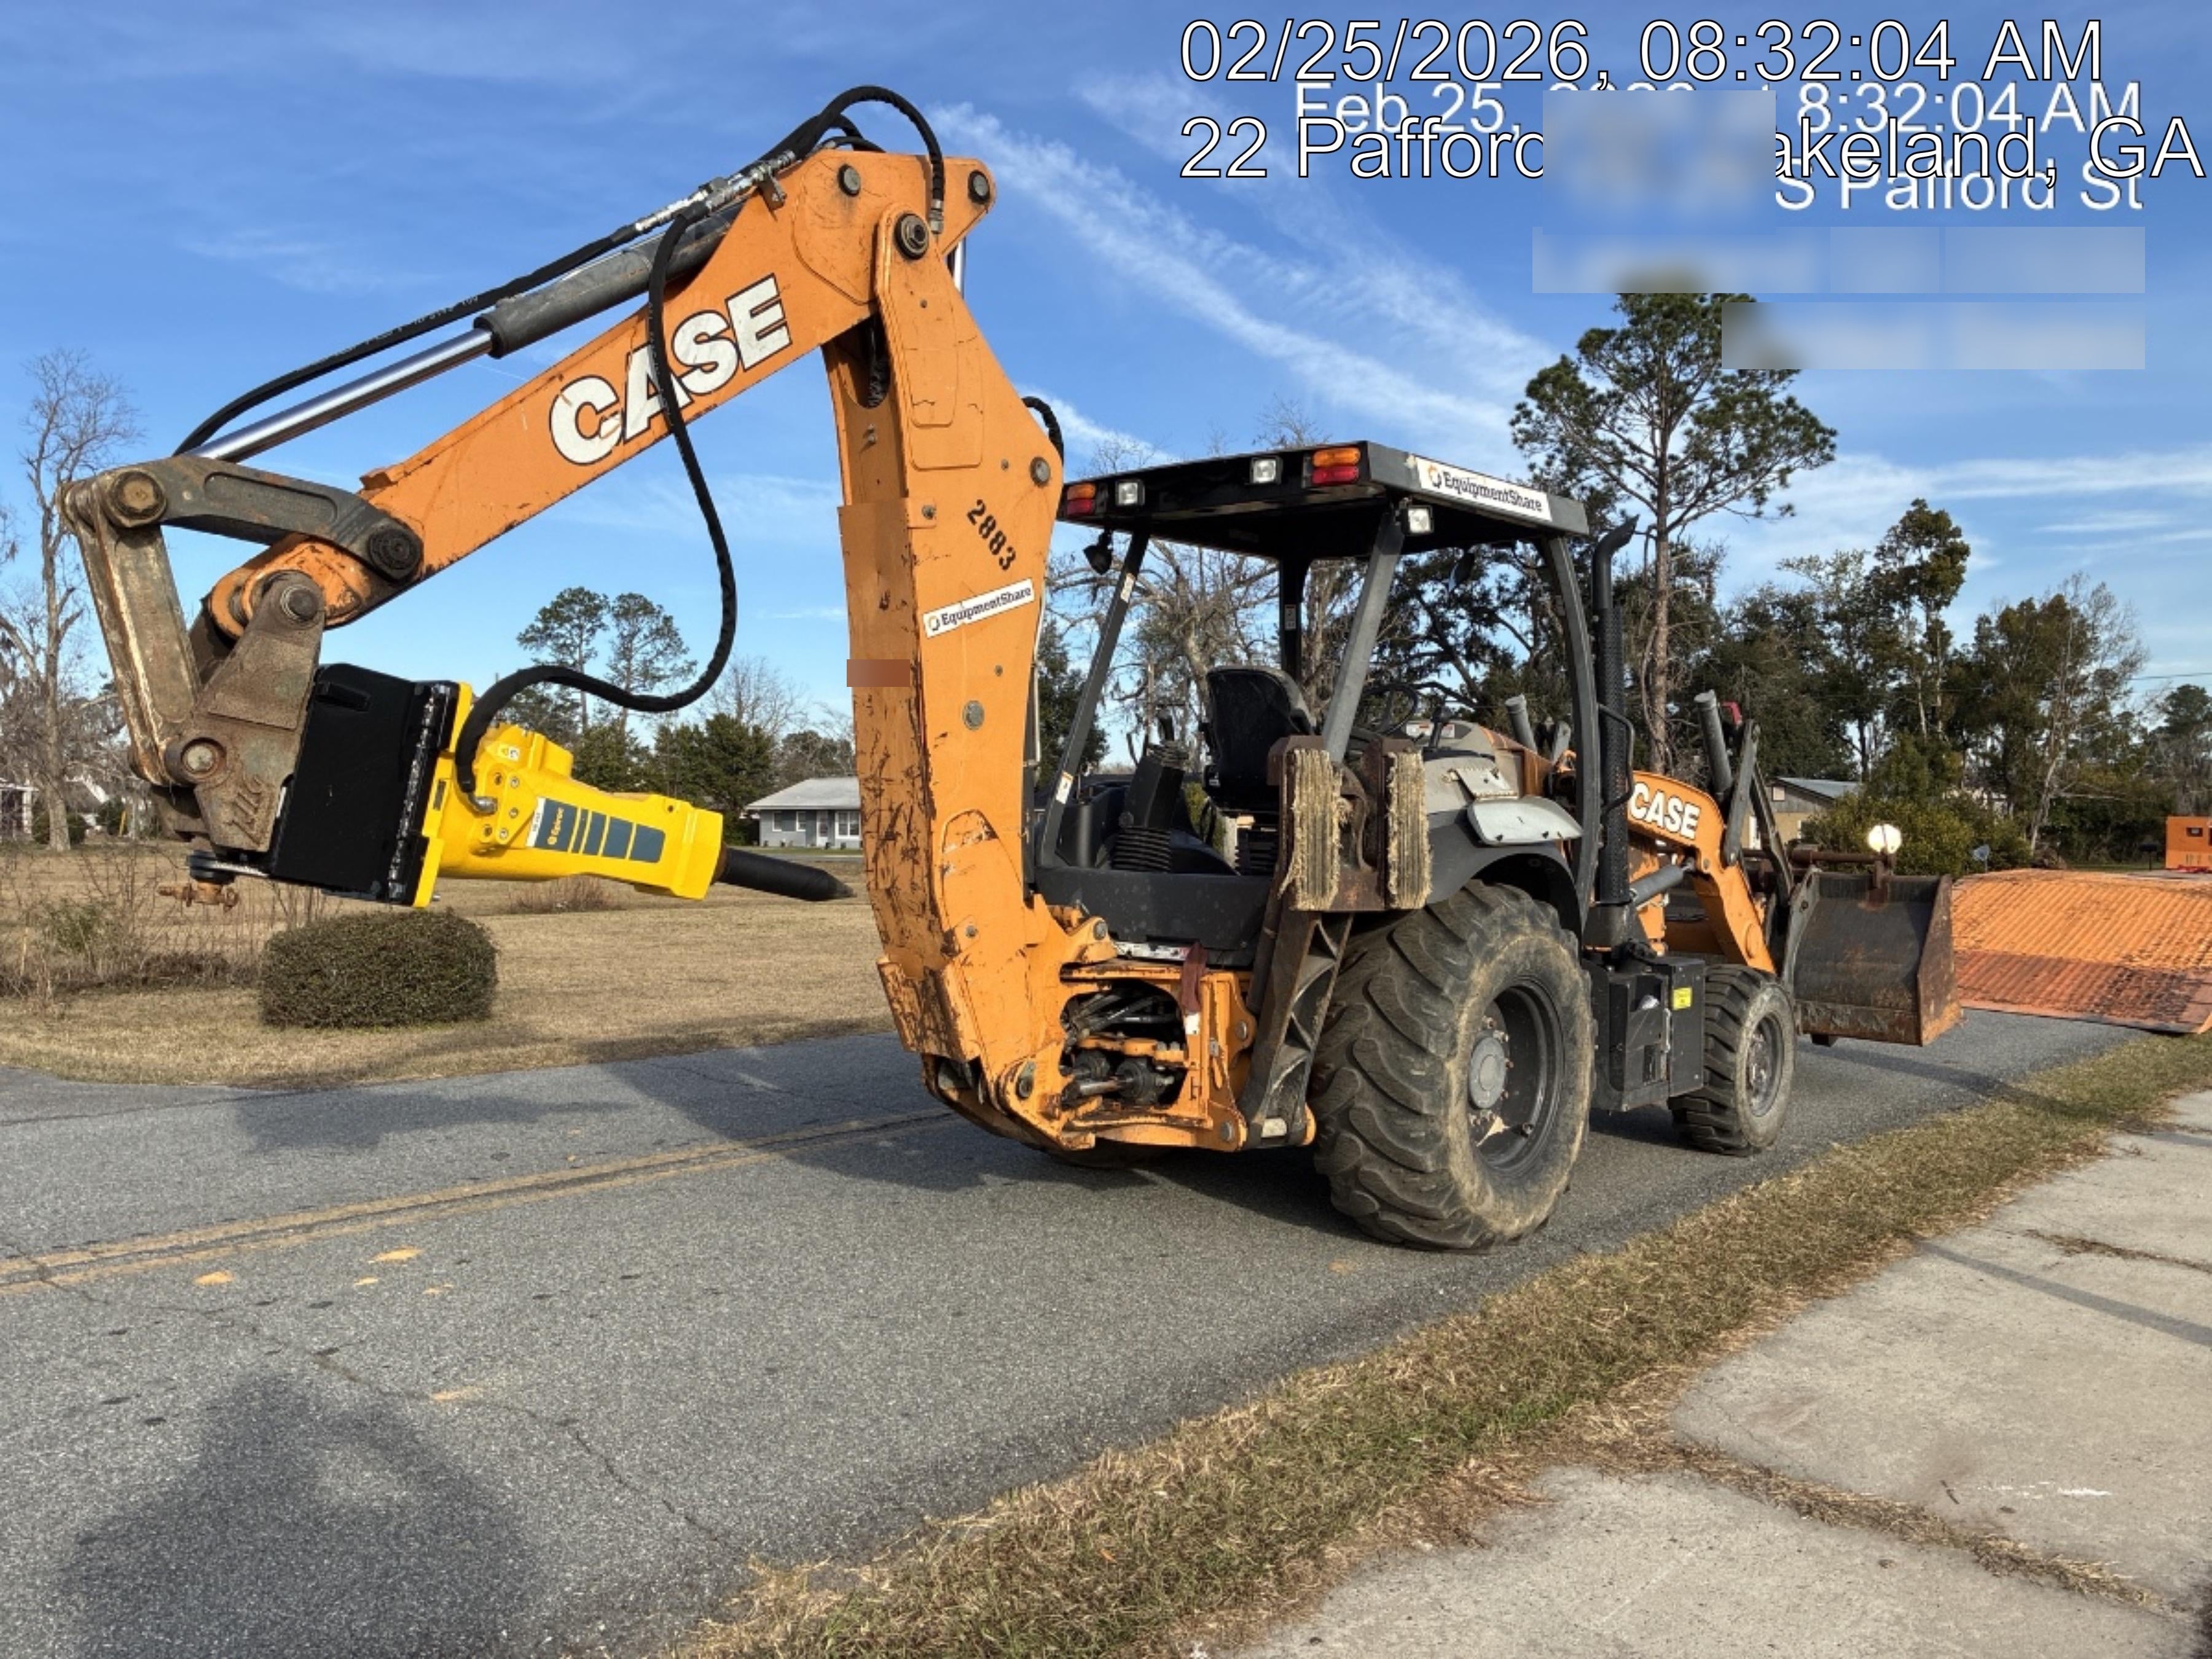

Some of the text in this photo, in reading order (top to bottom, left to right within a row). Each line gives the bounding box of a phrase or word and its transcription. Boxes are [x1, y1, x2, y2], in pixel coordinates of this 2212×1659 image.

[549, 272, 793, 466] CASE
[1444, 471, 1543, 512] EquipmentShare
[966, 499, 1017, 571] 2883
[941, 586, 1032, 626] EquipmentShare
[1628, 781, 1701, 841] CASE
